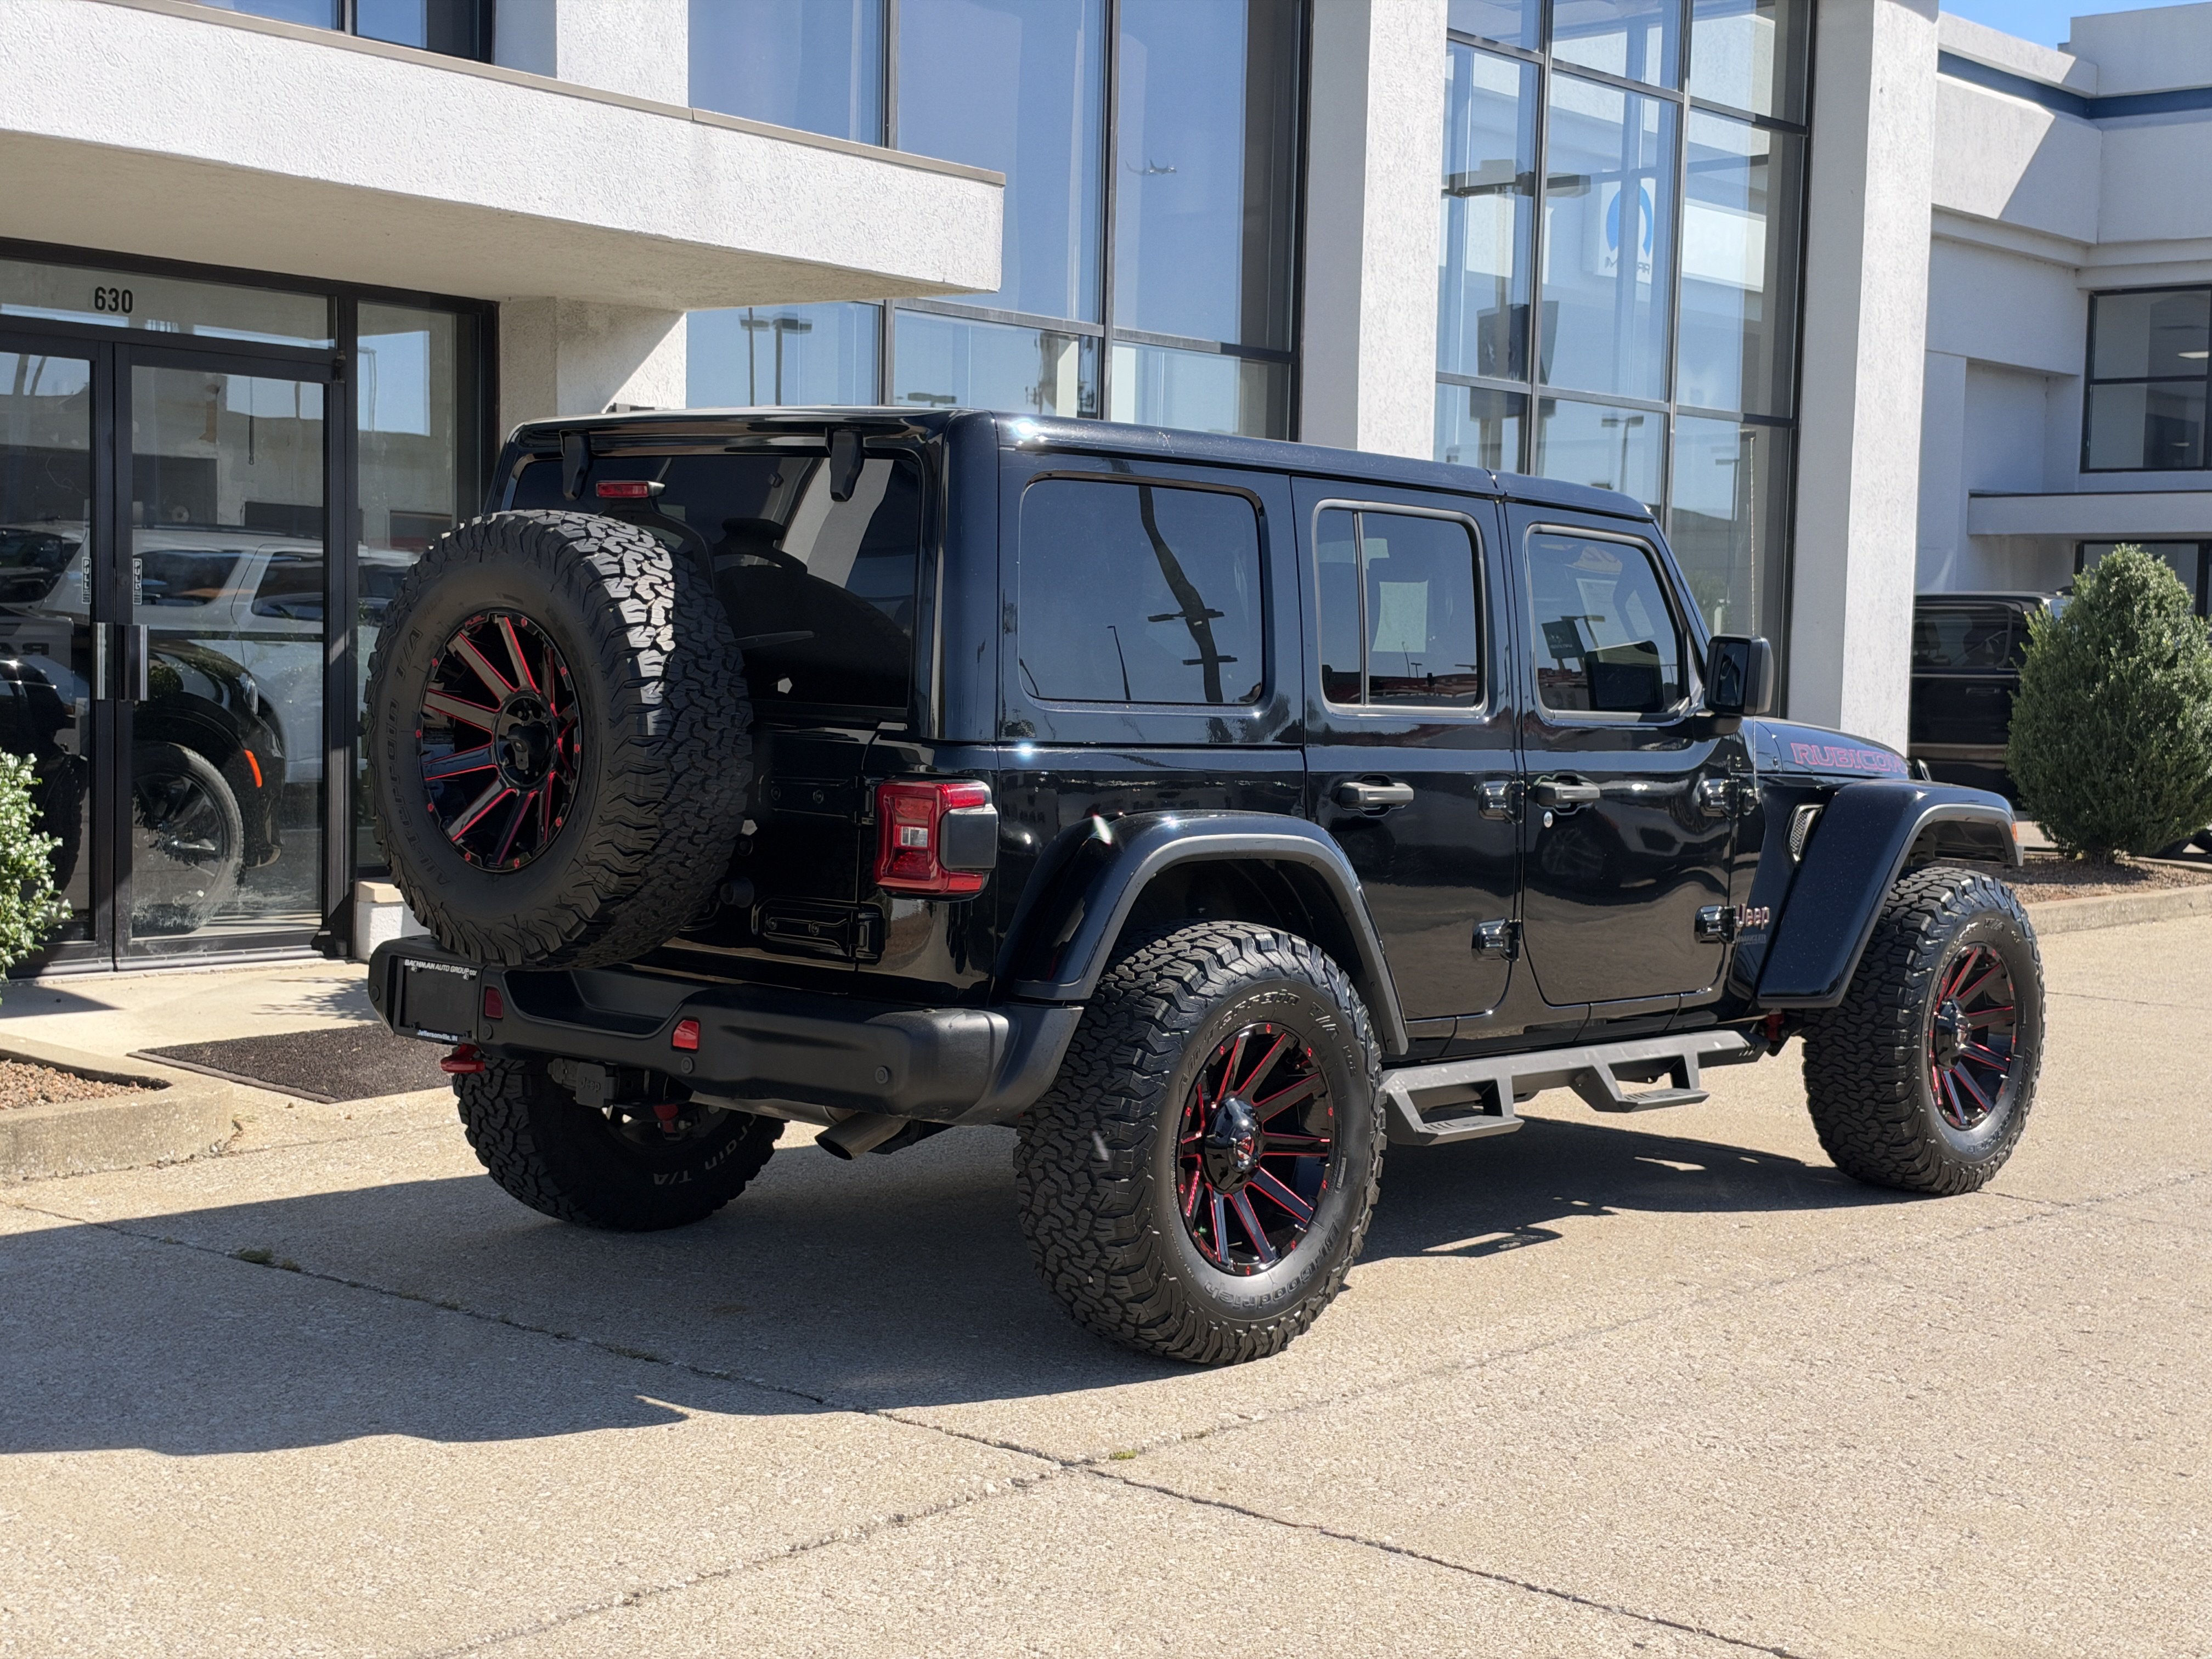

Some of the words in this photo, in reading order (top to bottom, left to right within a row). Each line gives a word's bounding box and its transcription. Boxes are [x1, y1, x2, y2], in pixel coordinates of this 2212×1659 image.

[1605, 256, 1650, 275] MAR
[94, 286, 133, 314] 630
[1790, 742, 1908, 774] RUBICON
[1733, 903, 1770, 930] Jeep
[404, 959, 435, 969] BACHMAN
[435, 963, 450, 972] AUTO
[580, 1076, 601, 1092] Jeep
